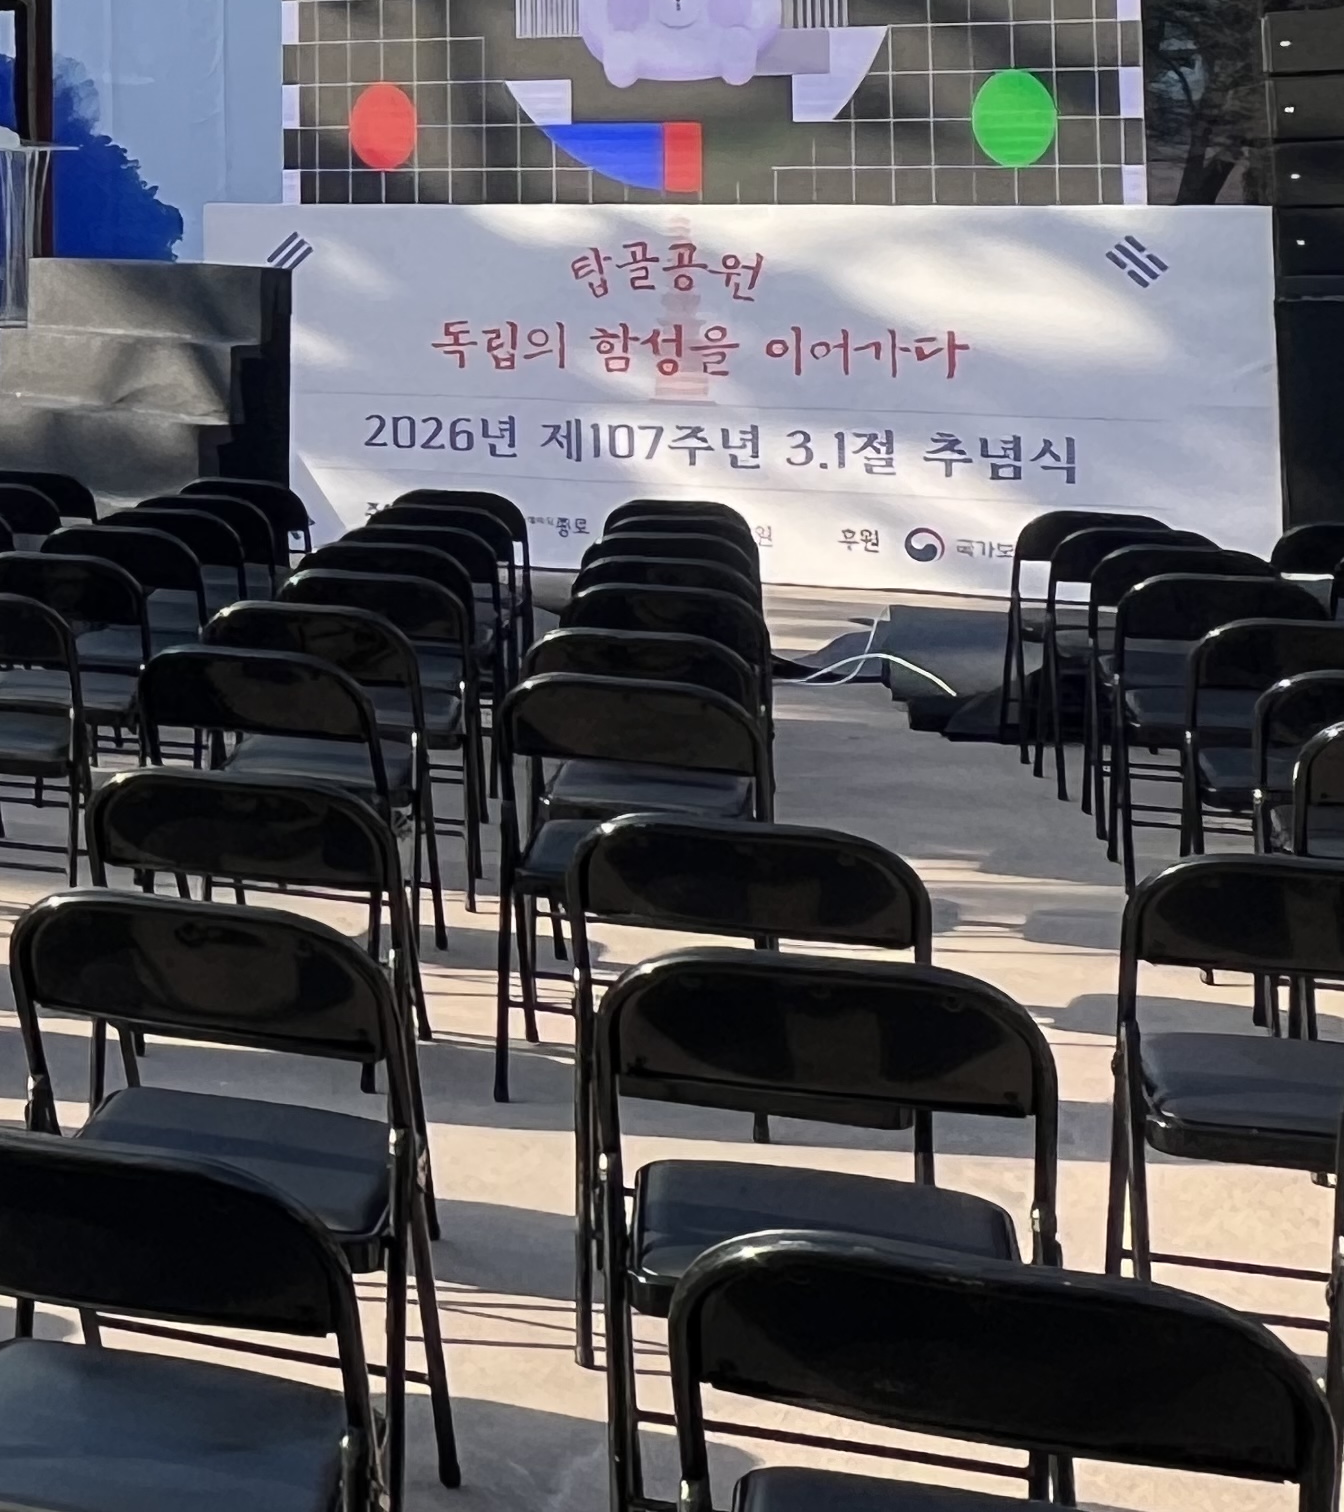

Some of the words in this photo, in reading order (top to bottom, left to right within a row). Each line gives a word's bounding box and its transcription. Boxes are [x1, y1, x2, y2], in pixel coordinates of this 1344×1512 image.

[570, 240, 765, 302] 탑골공원
[430, 320, 567, 371] 독립의
[588, 322, 740, 377] 함성을
[764, 325, 971, 379] 이어가다
[363, 414, 518, 459] 2026년
[540, 418, 761, 470] 제107주년
[785, 429, 897, 476] 3.1절
[923, 432, 1077, 485] 추념식
[837, 528, 880, 554] 후원
[955, 538, 1015, 559] 국가보
